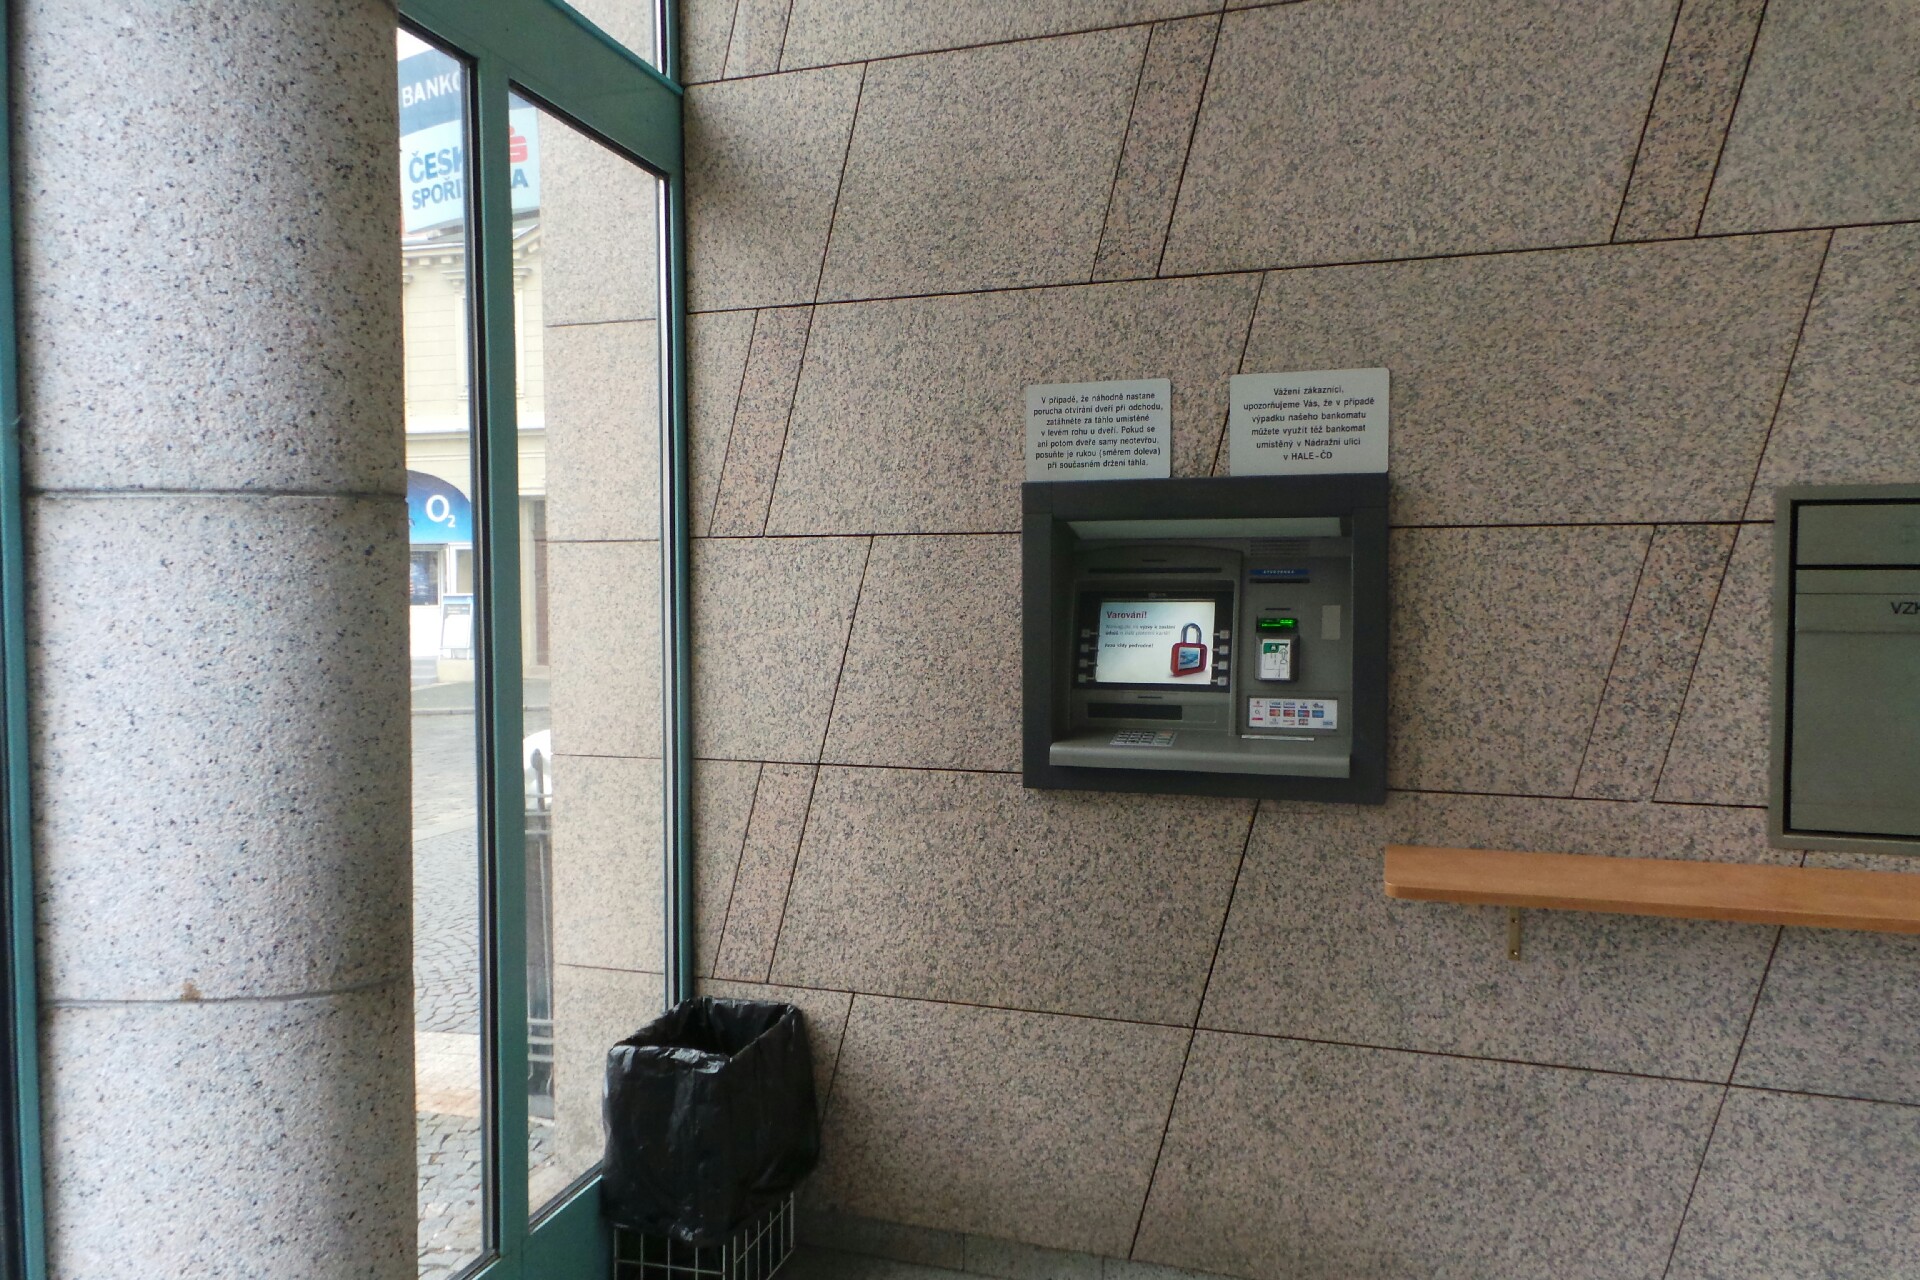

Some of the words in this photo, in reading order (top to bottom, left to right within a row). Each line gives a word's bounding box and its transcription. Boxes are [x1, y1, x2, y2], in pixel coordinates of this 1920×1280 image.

[1274, 387, 1300, 395] Vážení
[1049, 396, 1078, 405] případě,
[1092, 393, 1123, 401] náhodně
[1244, 401, 1299, 411] upozorňujeme
[1303, 399, 1320, 407] Vás,
[1344, 397, 1374, 407] případě
[1034, 408, 1062, 417] porucha
[1116, 414, 1149, 422] umístěné
[1252, 414, 1285, 424] výpadku
[1289, 413, 1318, 421] našeho
[1322, 411, 1366, 419] bankomatu
[1283, 426, 1307, 436] využít
[1311, 425, 1322, 433] též
[1051, 440, 1073, 448] potom
[1257, 440, 1293, 449] umístěný
[1305, 437, 1340, 446] Nádražní
[1036, 451, 1064, 460] posuňte
[1067, 451, 1073, 459] je
[1099, 448, 1130, 458] (směrem
[1048, 461, 1056, 470] při
[1060, 460, 1100, 468] současném
[1103, 459, 1125, 467] držení
[426, 494, 456, 528] O2
[1107, 611, 1147, 619] Varování!
